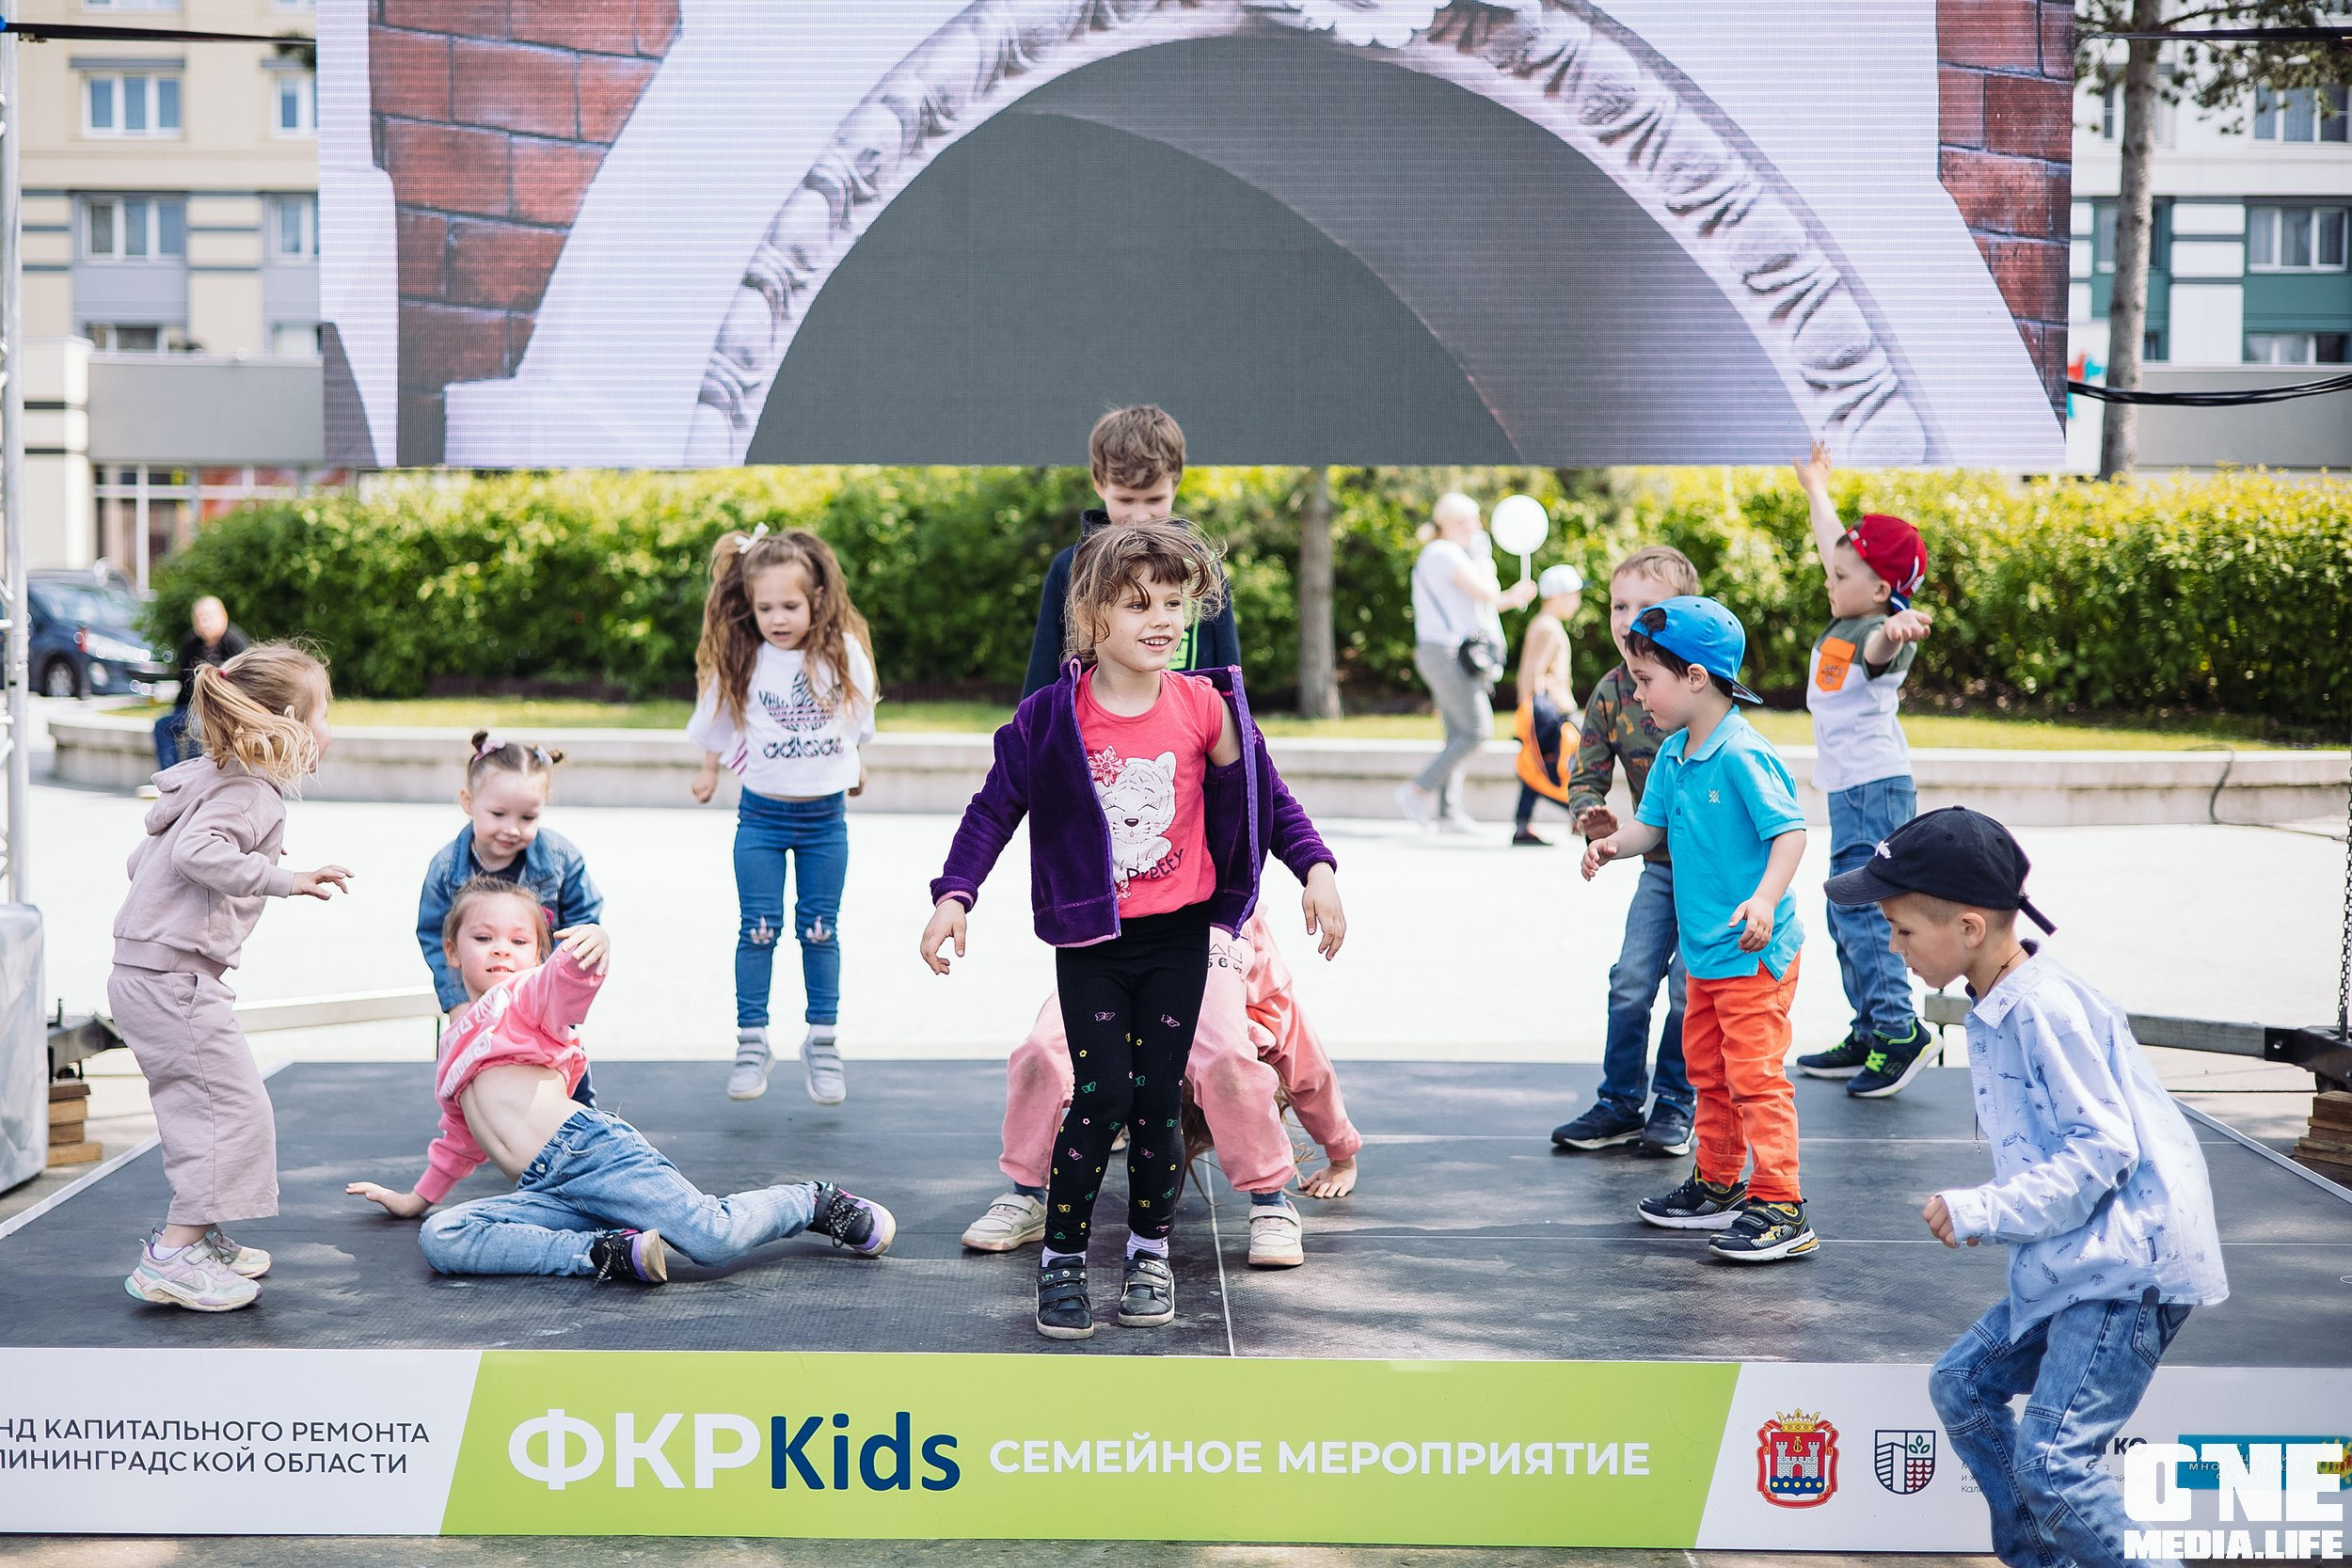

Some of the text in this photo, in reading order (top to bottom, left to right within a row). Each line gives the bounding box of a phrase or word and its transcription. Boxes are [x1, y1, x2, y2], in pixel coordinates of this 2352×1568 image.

[45, 1418, 283, 1442] КАПИТАЛЬНОГО
[293, 1421, 430, 1443] РЕМОНТА
[264, 1452, 406, 1474] ОБЛАСТИ
[990, 1432, 1263, 1474] СЕМЕЙНОЕ
[1279, 1441, 1650, 1476] МЕРОПРИЯТИЕ
